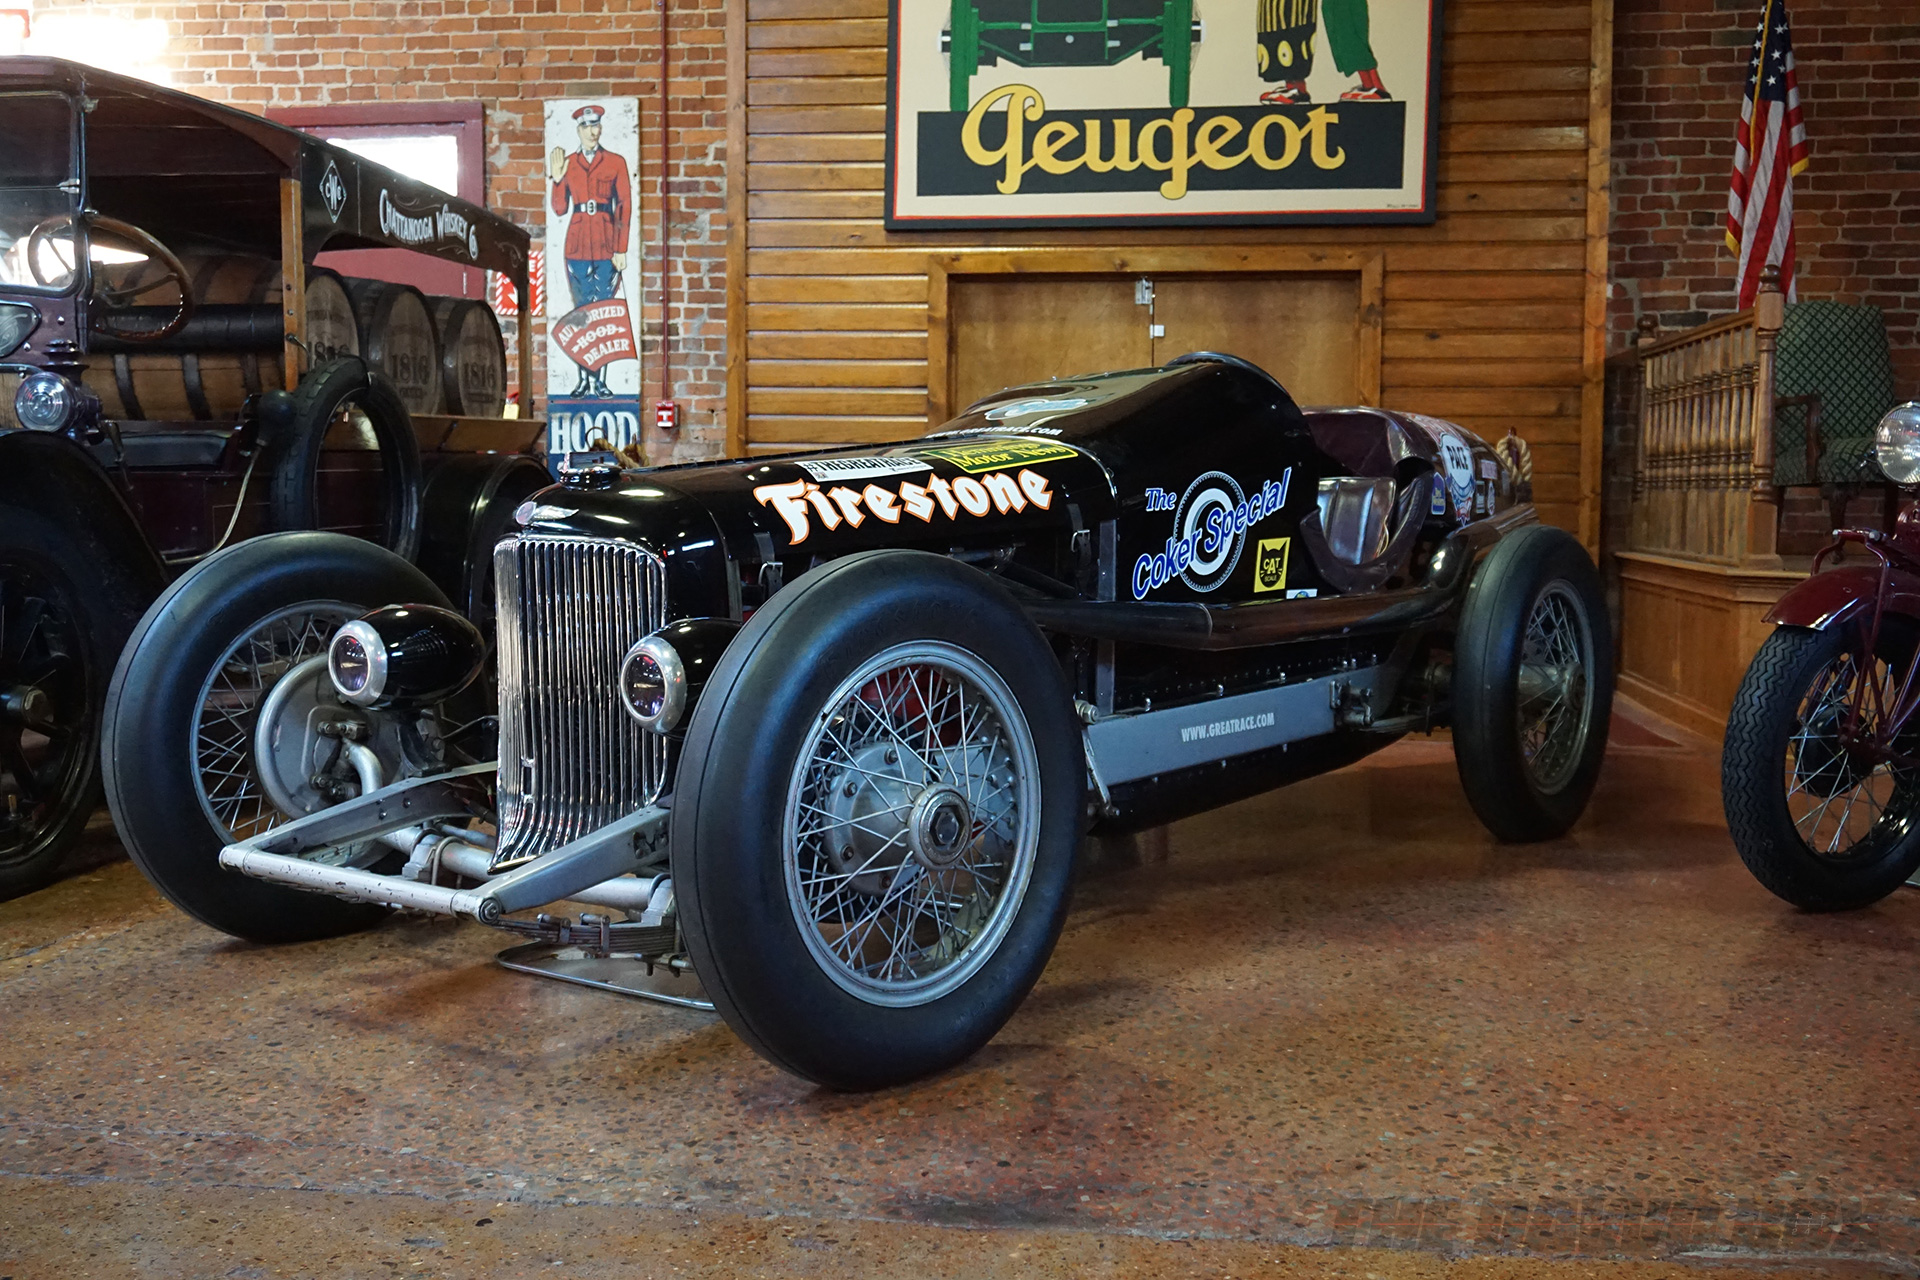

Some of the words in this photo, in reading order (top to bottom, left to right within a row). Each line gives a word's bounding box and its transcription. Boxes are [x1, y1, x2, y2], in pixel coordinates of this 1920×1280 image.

[961, 84, 1345, 200] Peugeot
[379, 188, 434, 243] CHATTANOOGA
[436, 203, 467, 243] WHISKEY
[576, 324, 617, 349] HOOD
[583, 338, 630, 366] DEALER
[550, 411, 640, 455] HOOD
[951, 451, 1014, 467] Motor
[1013, 445, 1067, 458] News
[753, 468, 1053, 545] Firestone
[1145, 487, 1177, 511] The
[1132, 528, 1203, 600] Coker
[1204, 466, 1292, 554] Special
[1263, 557, 1281, 574] CAT
[1181, 712, 1275, 742] WWW.GREATRACE.COM
